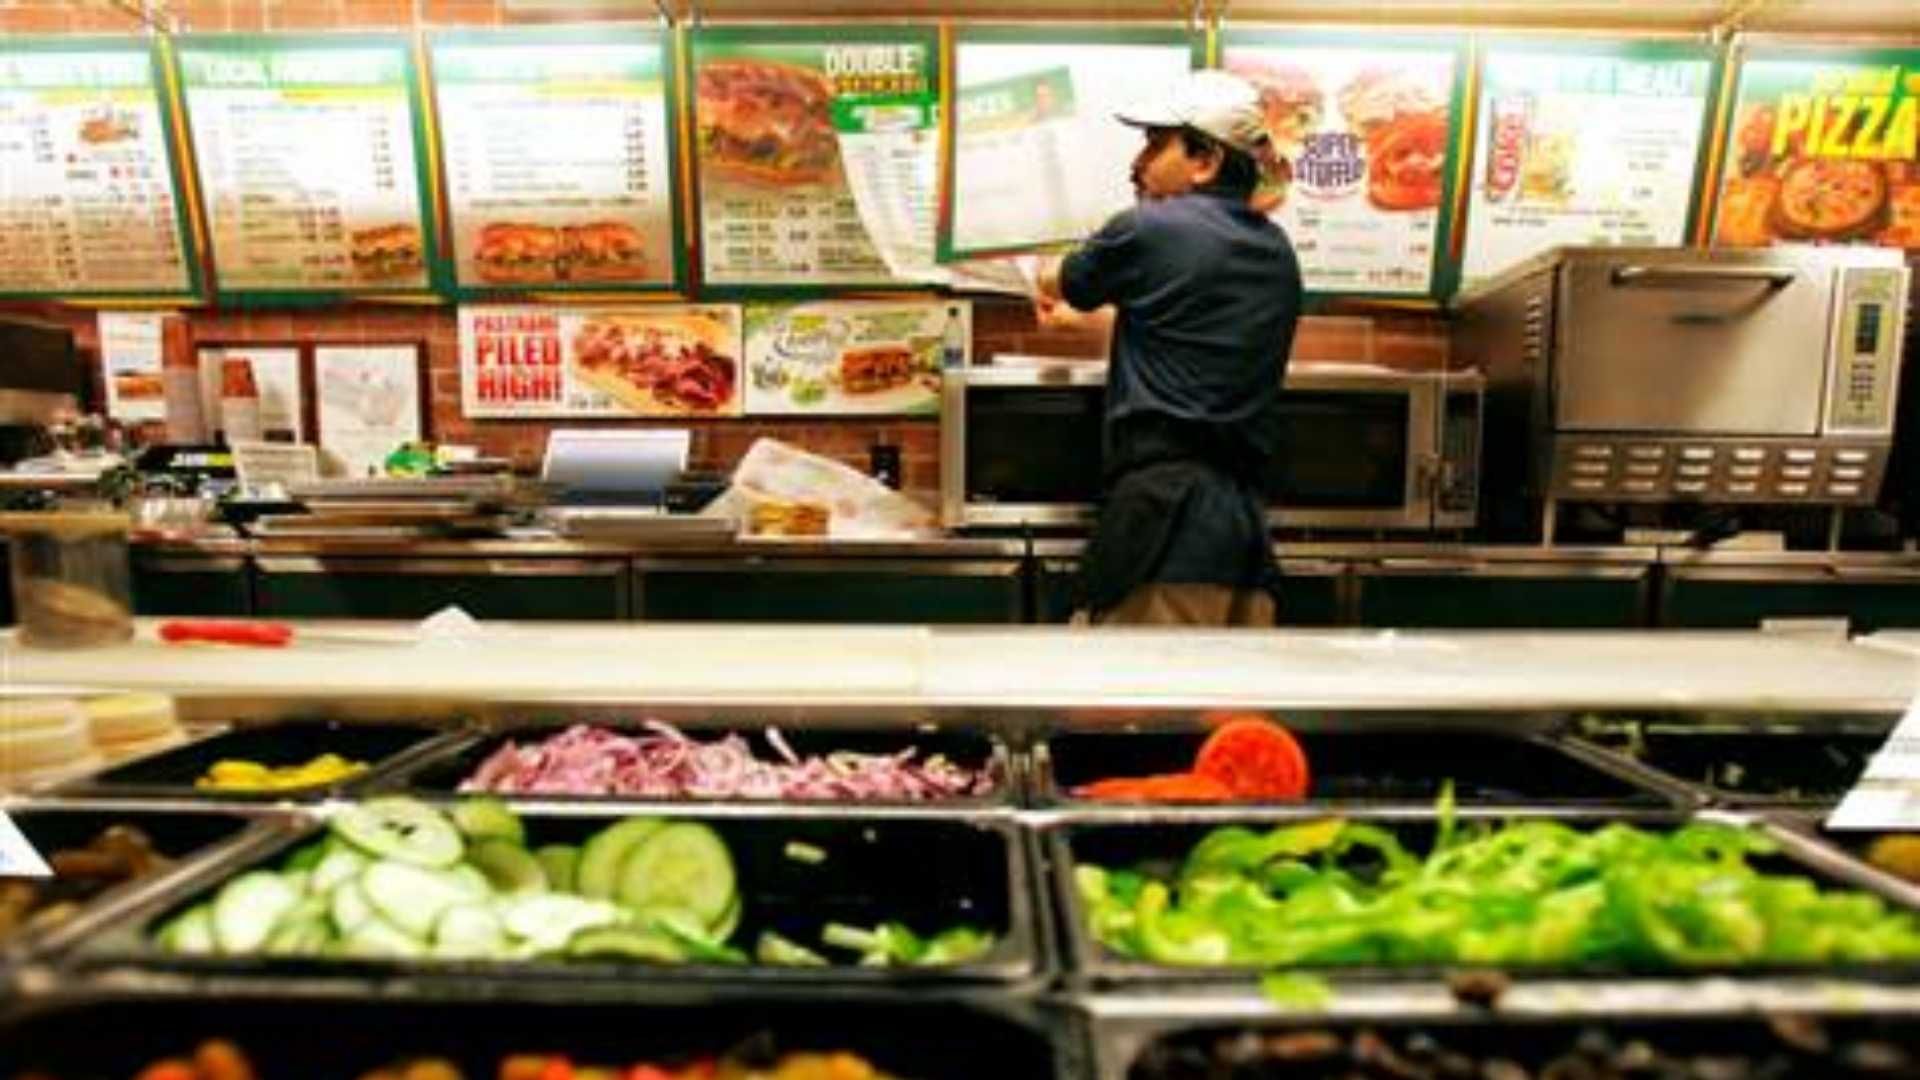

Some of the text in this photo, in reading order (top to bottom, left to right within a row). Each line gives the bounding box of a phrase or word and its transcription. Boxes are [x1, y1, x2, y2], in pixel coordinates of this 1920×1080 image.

[825, 45, 919, 74] DOUBLE
[1771, 93, 1917, 160] PIZZA
[1303, 133, 1358, 159] SUPER
[476, 335, 561, 366] PILED
[477, 368, 563, 402] HIGH!
